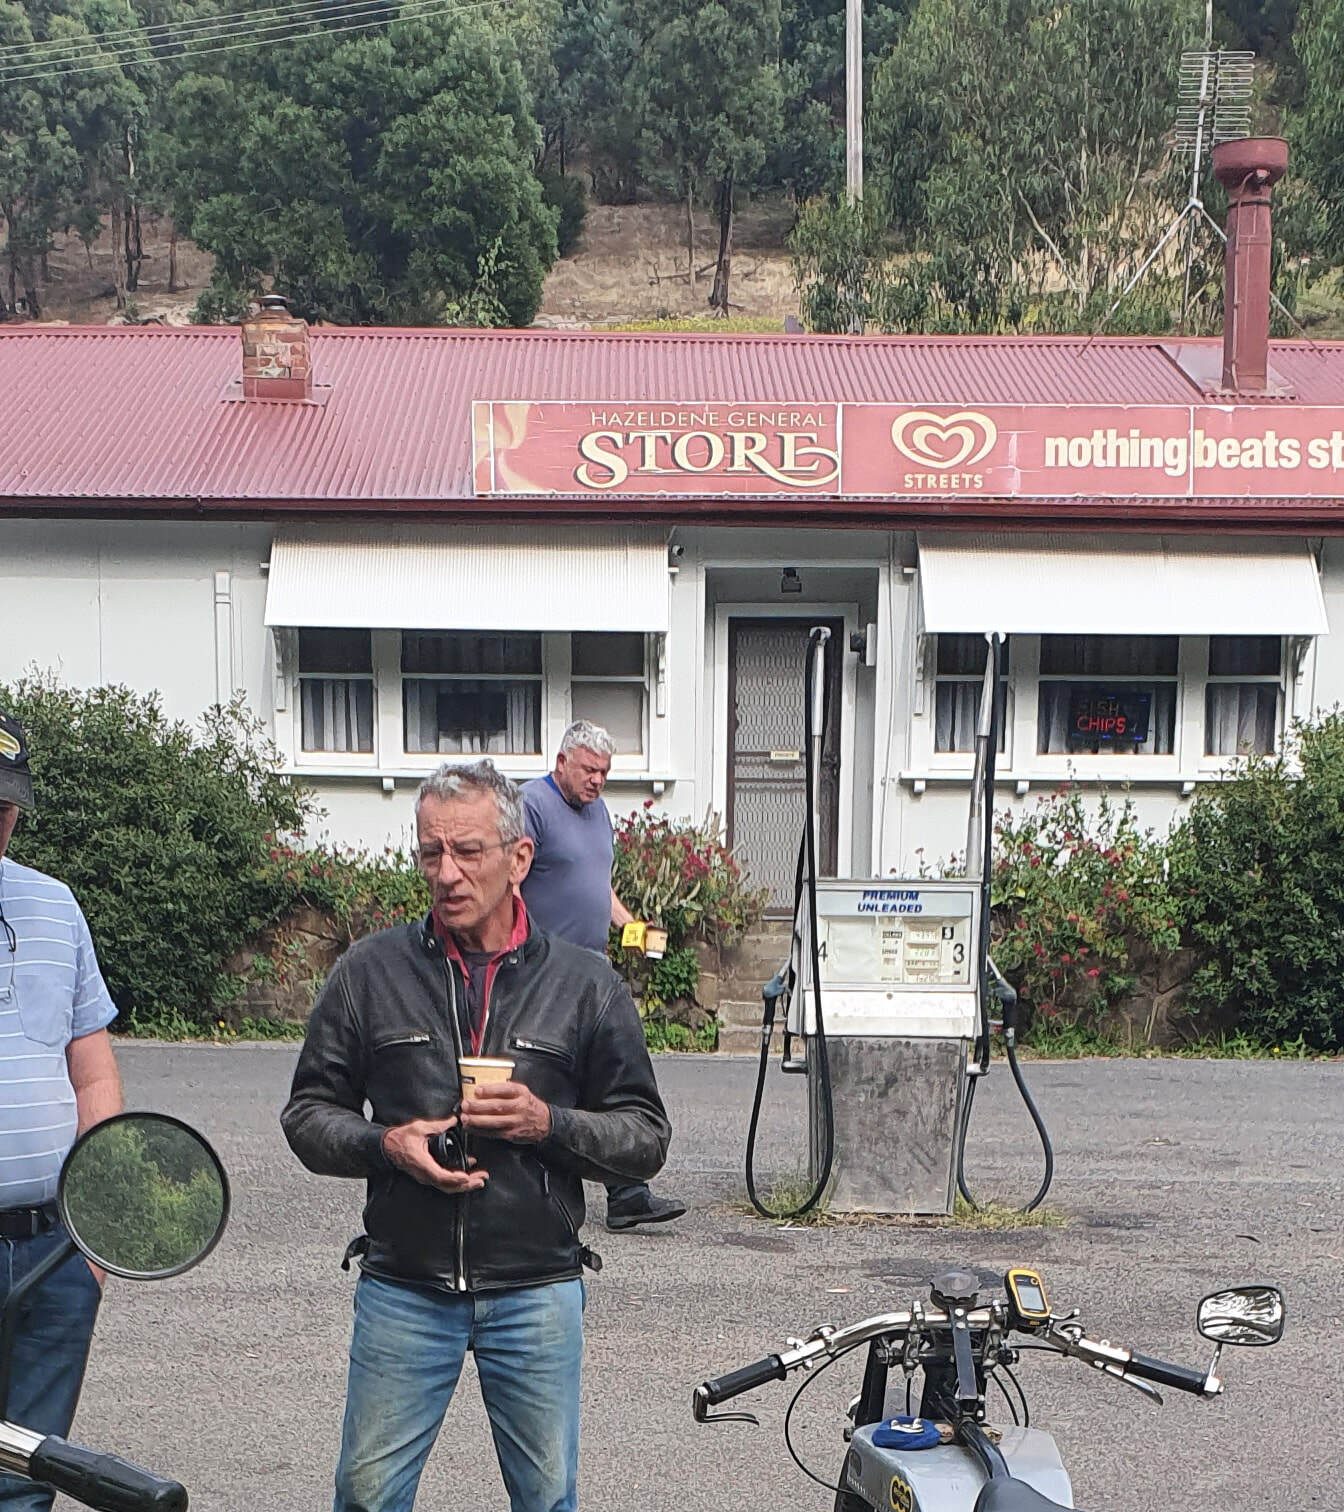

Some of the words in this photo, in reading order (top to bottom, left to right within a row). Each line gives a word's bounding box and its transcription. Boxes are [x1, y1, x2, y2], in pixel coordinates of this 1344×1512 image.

[590, 411, 719, 426] HAZELDENE
[727, 411, 827, 426] GENERAL
[574, 430, 840, 489] STORE
[1044, 428, 1188, 477] nothing
[1193, 428, 1302, 469] beats
[903, 472, 984, 489] STREETS
[1076, 714, 1126, 734] CHIPS
[862, 889, 921, 901] PREMIUM
[857, 903, 923, 914] UNLEADED
[952, 943, 965, 964] 3
